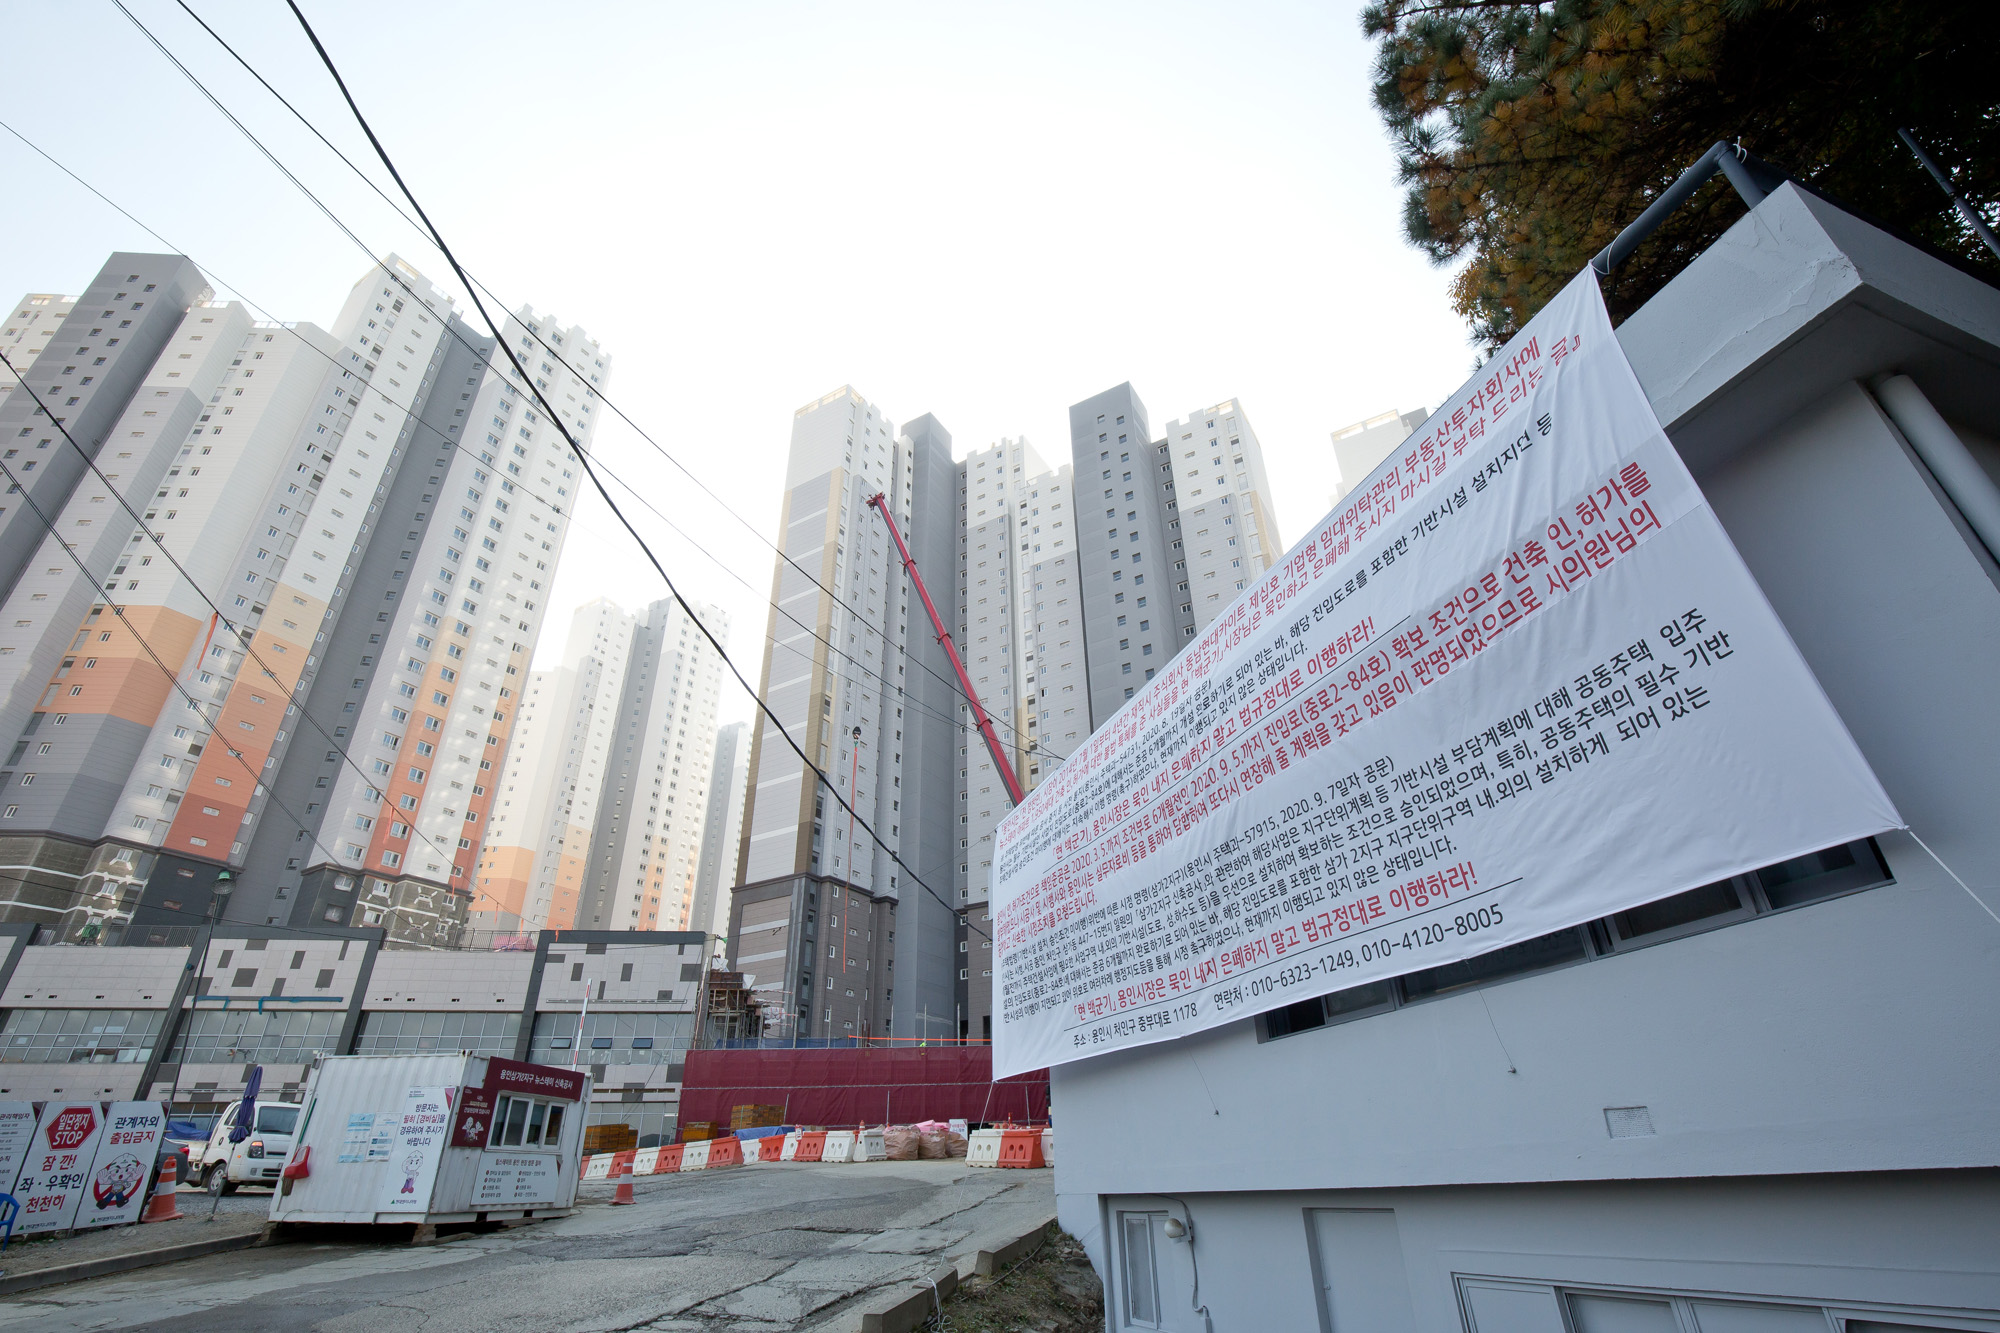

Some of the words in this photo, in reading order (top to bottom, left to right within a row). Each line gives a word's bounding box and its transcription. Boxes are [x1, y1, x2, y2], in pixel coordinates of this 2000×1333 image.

[1059, 757, 1077, 784] 2014년
[1079, 747, 1088, 765] 7월
[1090, 728, 1110, 754] 1일부터
[1112, 712, 1129, 734] 4년간
[1154, 662, 1183, 700] 주식회사
[1186, 603, 1246, 671] 동남현대카이트
[1249, 575, 1280, 618] 제십호
[1284, 540, 1316, 580] 기업형
[1321, 466, 1400, 550] 임대위탁관리
[1405, 336, 1540, 473] 부동산투자회사에
[1091, 751, 1103, 769] 대한
[1104, 739, 1116, 760] 불법
[1140, 714, 1146, 731] 준
[1149, 686, 1178, 720] 사실들을
[1181, 676, 1188, 695] 현
[1265, 571, 1308, 616] 묵인하고
[1311, 534, 1349, 579] 은폐해
[1354, 496, 1394, 542] 주시지
[1401, 451, 1446, 501] 마시길
[1453, 417, 1486, 456] 부탁
[1493, 366, 1543, 423] 드리는
[1136, 749, 1147, 767] 준공
[1149, 723, 1178, 755] 6개월까지
[1180, 709, 1194, 728] 개설
[1196, 676, 1234, 717] 완료하기로
[1236, 660, 1253, 682] 되어
[1255, 648, 1272, 668] 있는
[1275, 635, 1288, 649] 바,
[1290, 615, 1309, 637] 해당
[1312, 569, 1367, 622] 진입도로를
[1371, 536, 1408, 575] 포함한
[1411, 486, 1468, 540] 기반시설
[1472, 430, 1533, 493] 설치지연
[1537, 413, 1551, 436] 등
[1068, 872, 1094, 897] 용인시는
[1096, 849, 1130, 882] 실무자로비
[1131, 841, 1146, 862] 등을
[1148, 823, 1172, 853] 통하여
[1173, 799, 1208, 836] 담합하여
[1209, 777, 1240, 811] 또다시
[1240, 754, 1276, 791] 연장해
[1275, 746, 1290, 770] 줄
[1290, 722, 1331, 758] 계획을
[1331, 704, 1363, 737] 갖고
[1363, 670, 1413, 718] 있음이
[1411, 586, 1543, 686] 판명되었으므로
[1546, 500, 1661, 594] 시의원님의
[1093, 799, 1130, 839] 용인시장은
[1133, 784, 1149, 807] 묵인
[1151, 768, 1169, 793] 내지
[1172, 736, 1213, 780] 은폐하지
[1213, 717, 1237, 750] 말고
[1239, 669, 1307, 727] 법규정대로
[1307, 616, 1375, 686] 이행하라!
[1122, 814, 1152, 844] 조건부로
[1152, 785, 1191, 824] 6개월전인
[1191, 767, 1219, 797] 2020.
[1392, 625, 1429, 659] 확보
[1428, 572, 1502, 637] 조건으로
[1502, 540, 1549, 584] 건축
[1160, 733, 1187, 763] 현재까지
[1189, 709, 1217, 738] 이행되고
[1219, 692, 1236, 716] 있지
[1238, 678, 1255, 701] 않은
[1258, 640, 1307, 685] 상태입니다.
[1214, 852, 1252, 882] 관련하여
[1252, 827, 1300, 861] 해당사업은
[1302, 791, 1374, 835] 지구단위계획
[1375, 785, 1389, 803] 등
[1391, 754, 1449, 793] 기반시설
[1451, 709, 1534, 765] 부담계획에
[1534, 686, 1573, 718] 대해
[1574, 639, 1654, 699] 공동주택
[1660, 608, 1706, 647] 입주
[1222, 872, 1257, 900] 우선으로
[1259, 851, 1297, 882] 설치하여
[1298, 833, 1344, 860] 확보하는
[1346, 807, 1397, 840] 조건으로
[1400, 762, 1494, 818] 승인되었으며,
[1496, 740, 1538, 769] 특히,
[1540, 685, 1635, 750] 공동주택의
[1635, 663, 1679, 697] 필수
[1683, 631, 1734, 668] 기반
[1280, 799, 1313, 823] 2020.
[1328, 772, 1361, 800] 7일자
[1364, 756, 1394, 783] 공문)
[1093, 959, 1105, 975] 준공
[1106, 947, 1135, 973] 6개월까지
[1136, 933, 1173, 958] 완료하기로
[1174, 925, 1190, 942] 되어
[1189, 919, 1208, 936] 있는
[1208, 912, 1222, 926] 바,
[1223, 901, 1240, 920] 해당
[1242, 879, 1288, 912] 진입도로를
[1289, 863, 1322, 889] 포함한
[1325, 852, 1348, 876] 삼가
[1350, 838, 1384, 863] 2지구
[1387, 798, 1474, 847] 지구단위구역
[1536, 732, 1609, 784] 설치하게
[1616, 706, 1661, 741] 되어
[1662, 686, 1710, 721] 있는
[1118, 978, 1166, 1008] 용인시장은
[1169, 968, 1191, 992] 묵인
[1194, 957, 1218, 983] 내지
[1221, 937, 1273, 975] 은폐하지
[1271, 926, 1303, 962] 말고
[1302, 895, 1386, 951] 법규정대로
[1389, 861, 1477, 911] 이행하라!
[1156, 952, 1172, 969] 통해
[1174, 945, 1189, 961] 시정
[1190, 922, 1244, 955] 촉구하였으나,
[1245, 904, 1281, 933] 현재까지
[1283, 886, 1325, 914] 이행되고
[1327, 875, 1352, 899] 있지
[1353, 865, 1379, 889] 않은
[1383, 835, 1457, 877] 상태입니다.
[1074, 1034, 1086, 1048] 주소
[1092, 1025, 1112, 1043] 용인시
[1114, 1019, 1136, 1036] 처인구
[1138, 1011, 1171, 1032] 중부대로
[1173, 1003, 1197, 1021] 1178
[1214, 985, 1243, 1010] 연락처
[1252, 950, 1359, 996] 010-6323-1249,
[1362, 903, 1503, 962] 010-4120-8005
[53, 1131, 83, 1146] STOP
[58, 1113, 90, 1130] 일단정지
[110, 1130, 155, 1145] 출입금지
[114, 1116, 160, 1130] 관계자외
[400, 1125, 424, 1136] 경유하여
[425, 1125, 444, 1135] 주시기
[406, 1137, 431, 1147] 바랍니다
[416, 1103, 439, 1113] 방문자는
[500, 1069, 534, 1083] 용인삼가2지구
[534, 1074, 554, 1087] 뉴스테이
[555, 1079, 573, 1090] 신축공사
[26, 1194, 66, 1214] 천천히
[42, 1155, 56, 1172] 잠
[59, 1154, 77, 1171] 깐!
